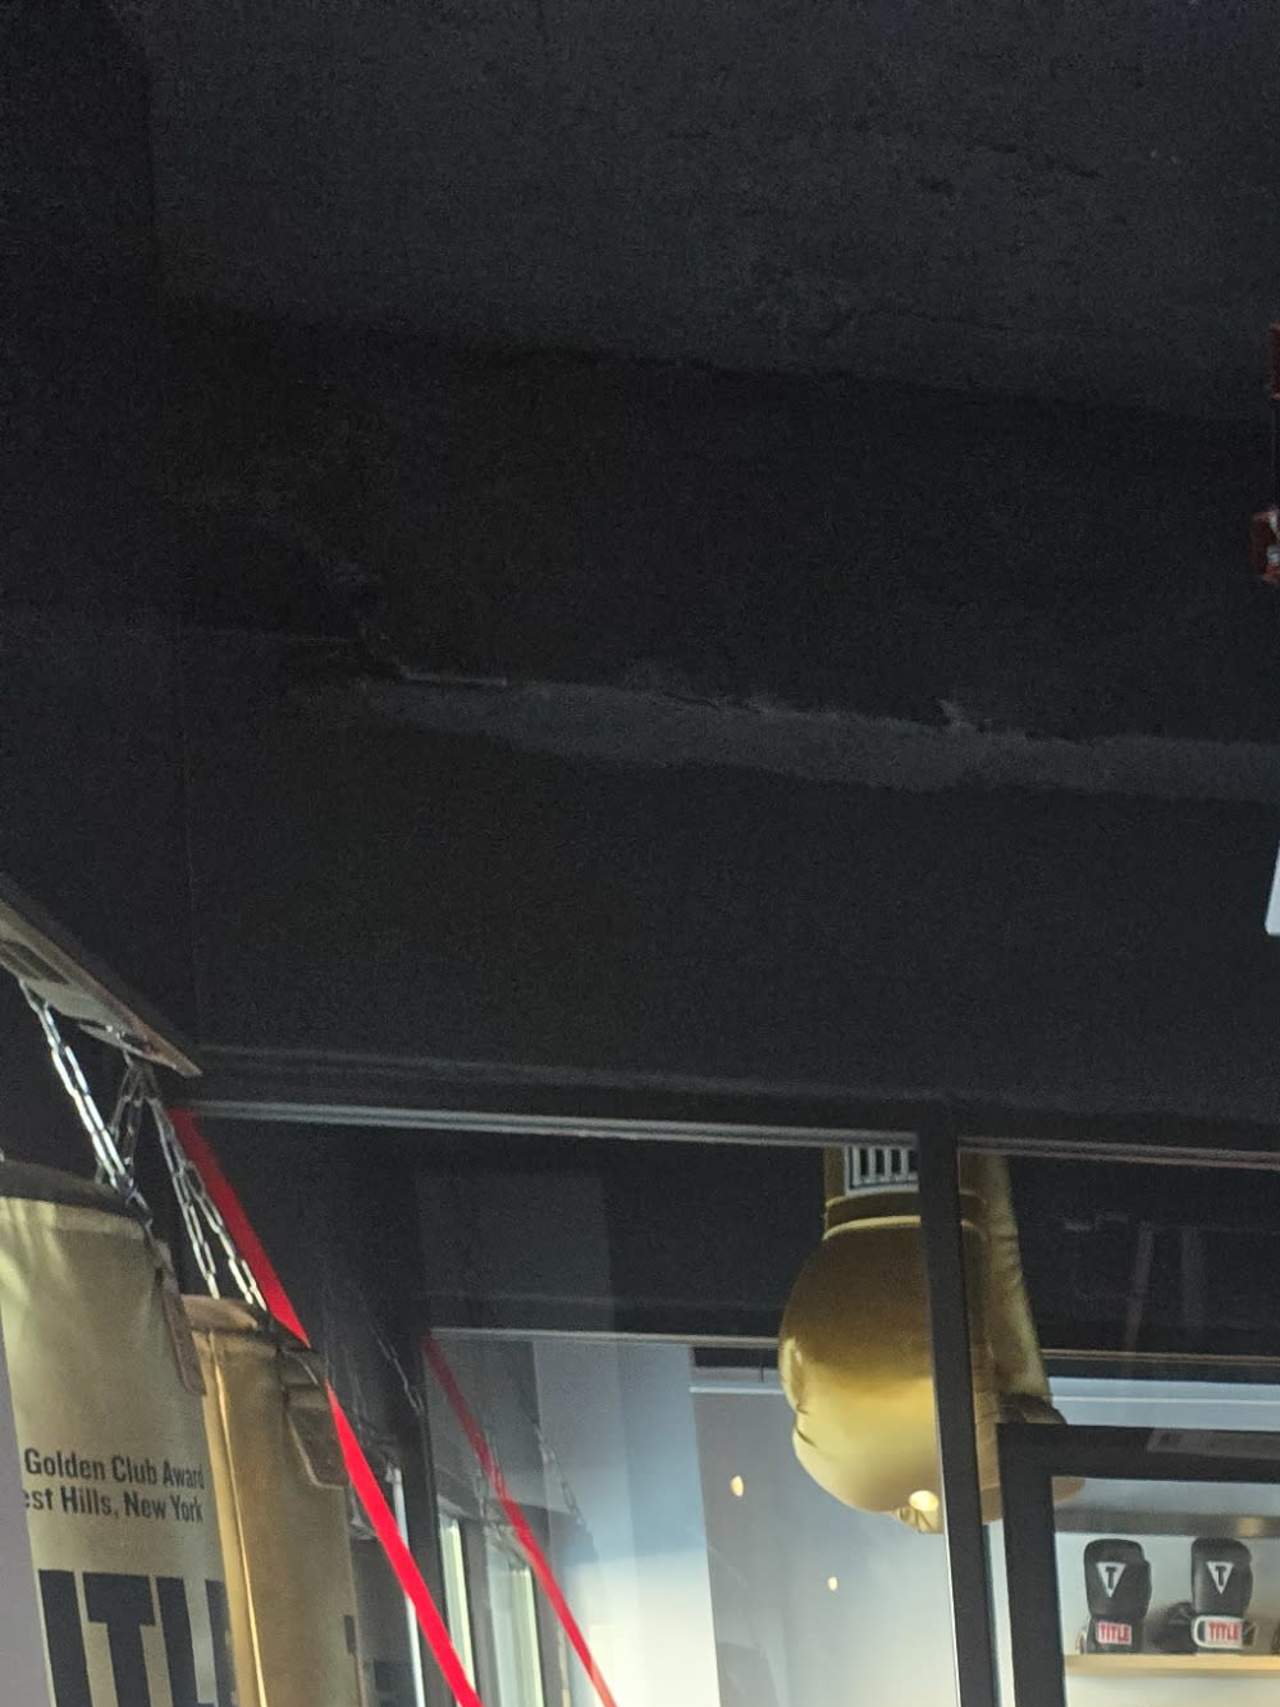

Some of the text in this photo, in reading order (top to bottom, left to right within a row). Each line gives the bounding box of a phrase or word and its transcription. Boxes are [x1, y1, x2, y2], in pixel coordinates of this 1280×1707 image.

[24, 1448, 106, 1482] Golden
[111, 1454, 158, 1485] Club
[61, 1485, 119, 1519] Hills,
[124, 1491, 167, 1519] New
[169, 1494, 205, 1523] York
[1099, 1621, 1131, 1643] TITLE
[1208, 1621, 1240, 1642] TITLE
